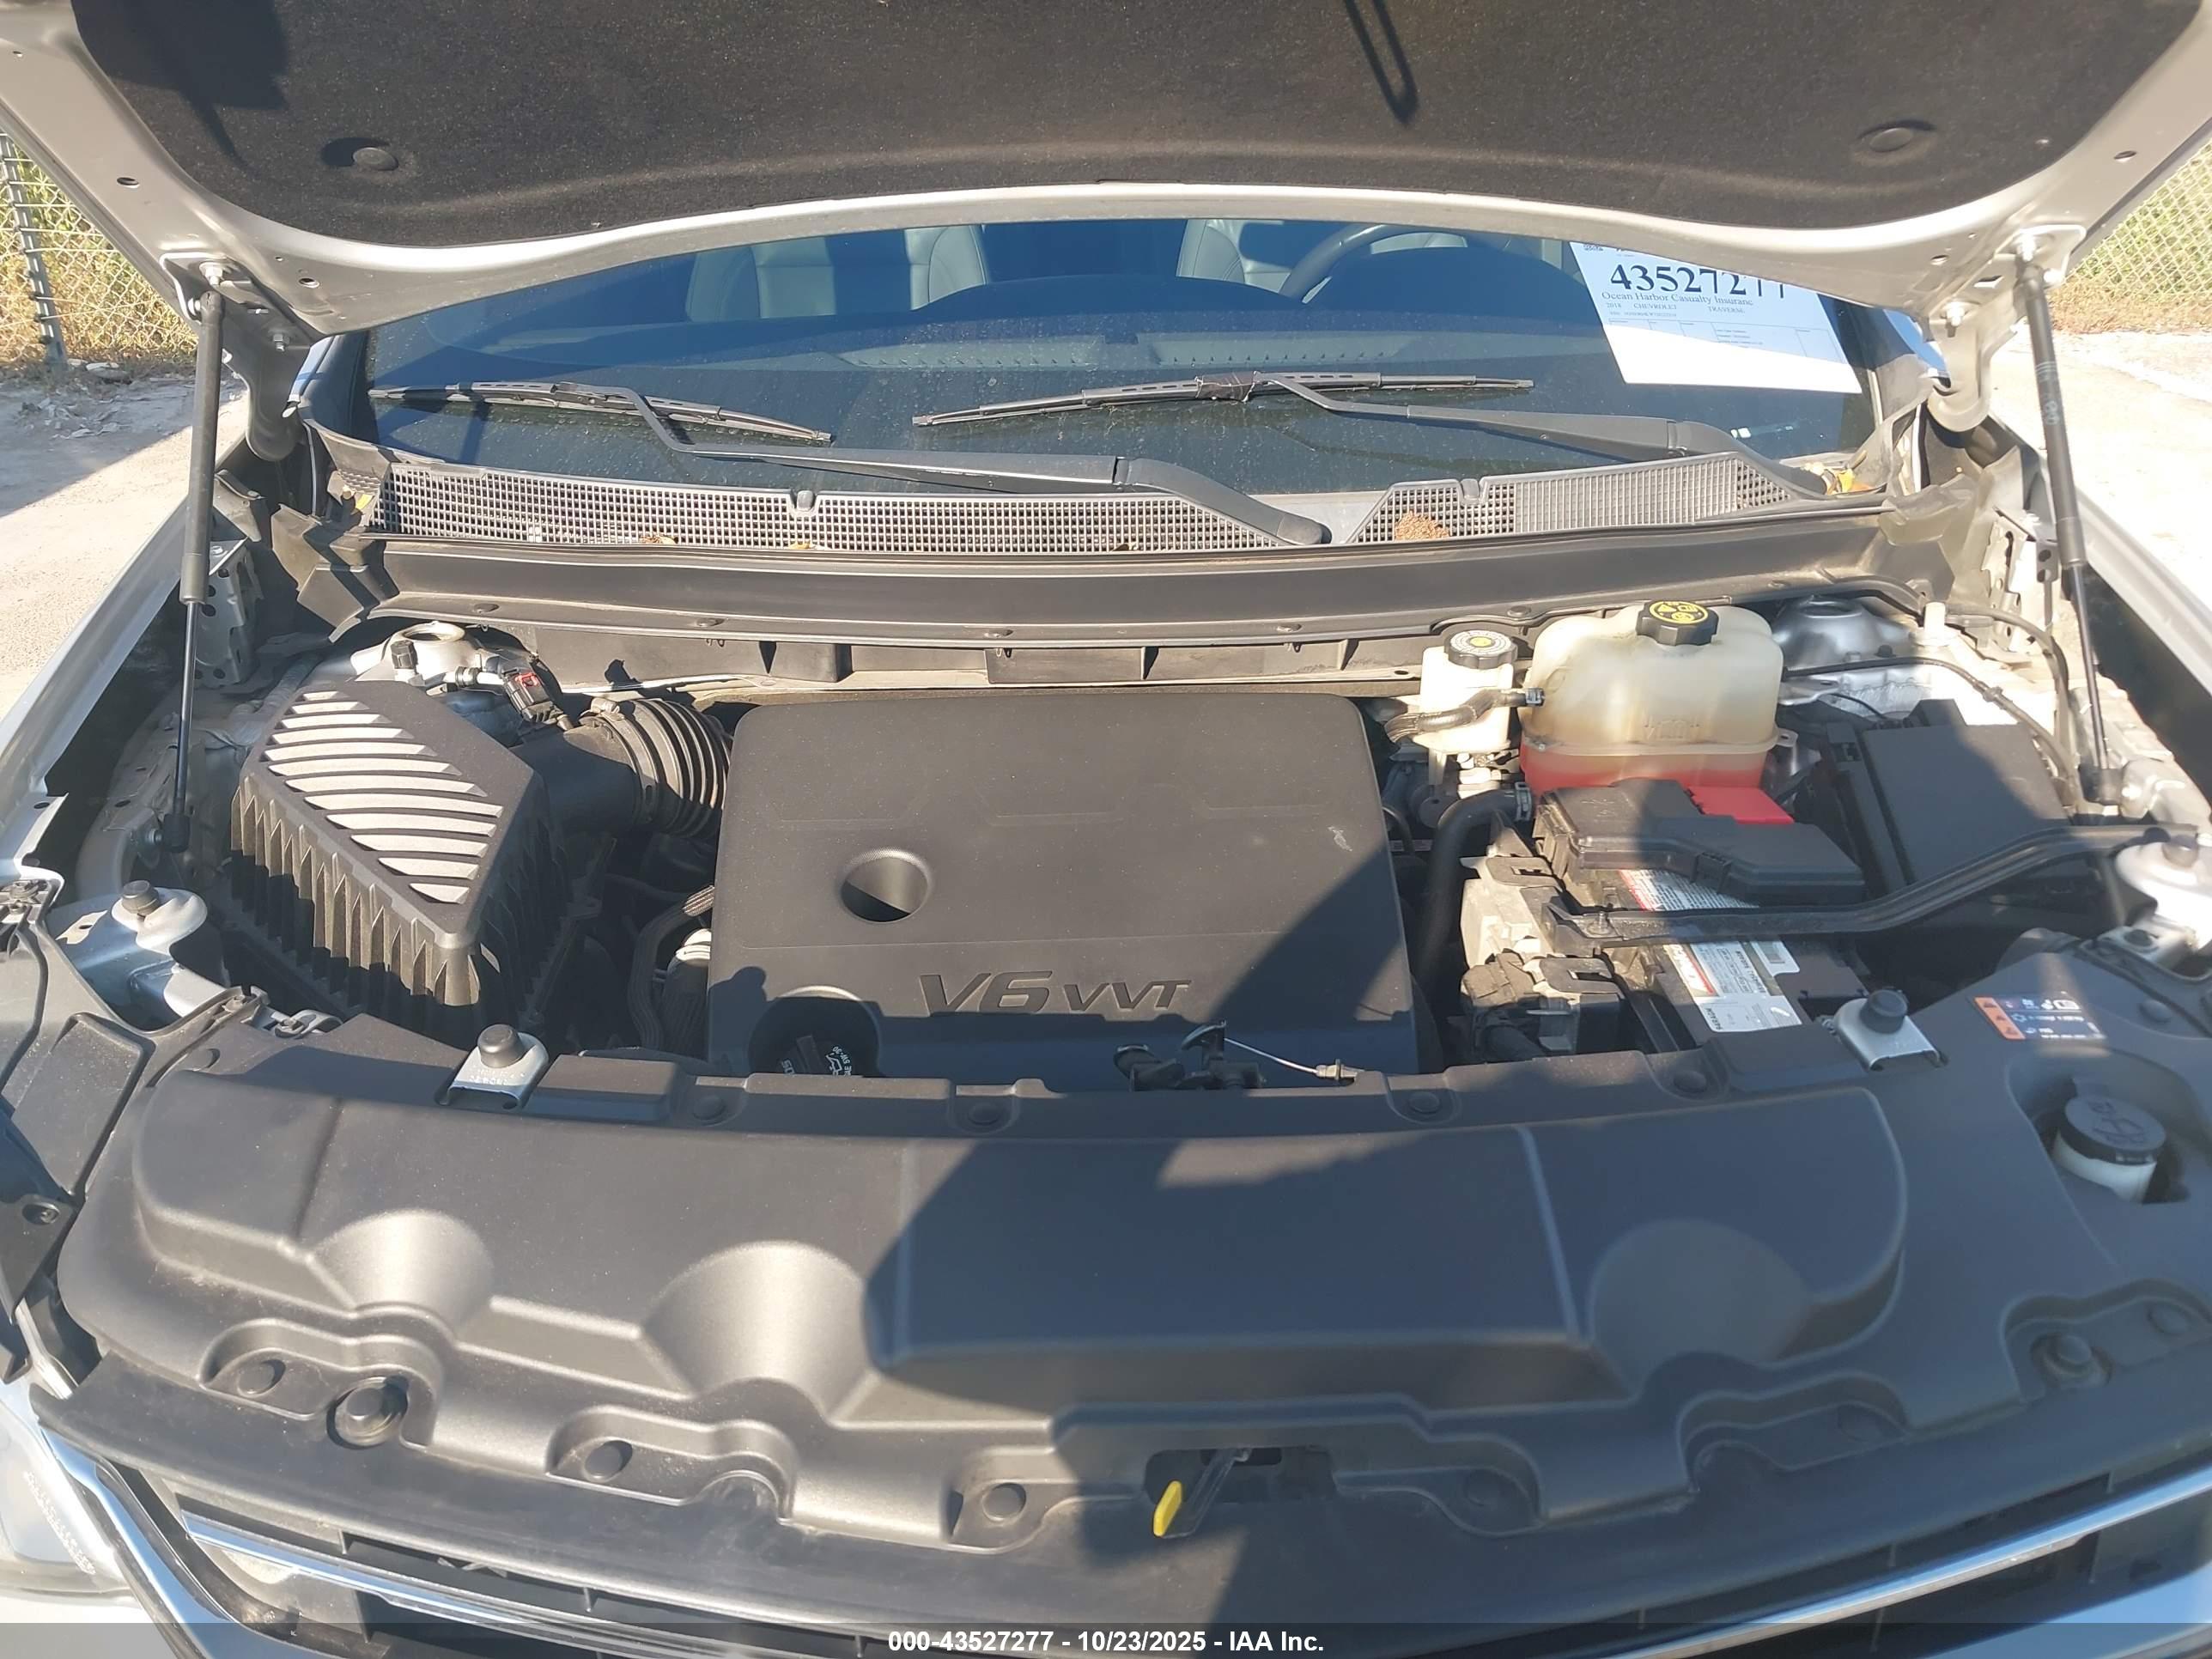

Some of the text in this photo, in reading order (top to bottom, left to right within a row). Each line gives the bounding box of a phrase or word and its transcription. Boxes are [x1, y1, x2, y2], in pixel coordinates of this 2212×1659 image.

[1601, 291, 1633, 301] Ocean
[1636, 293, 1668, 302] Harbor
[1671, 294, 1712, 306] Casualty
[920, 970, 1192, 1017] V6 VVT
